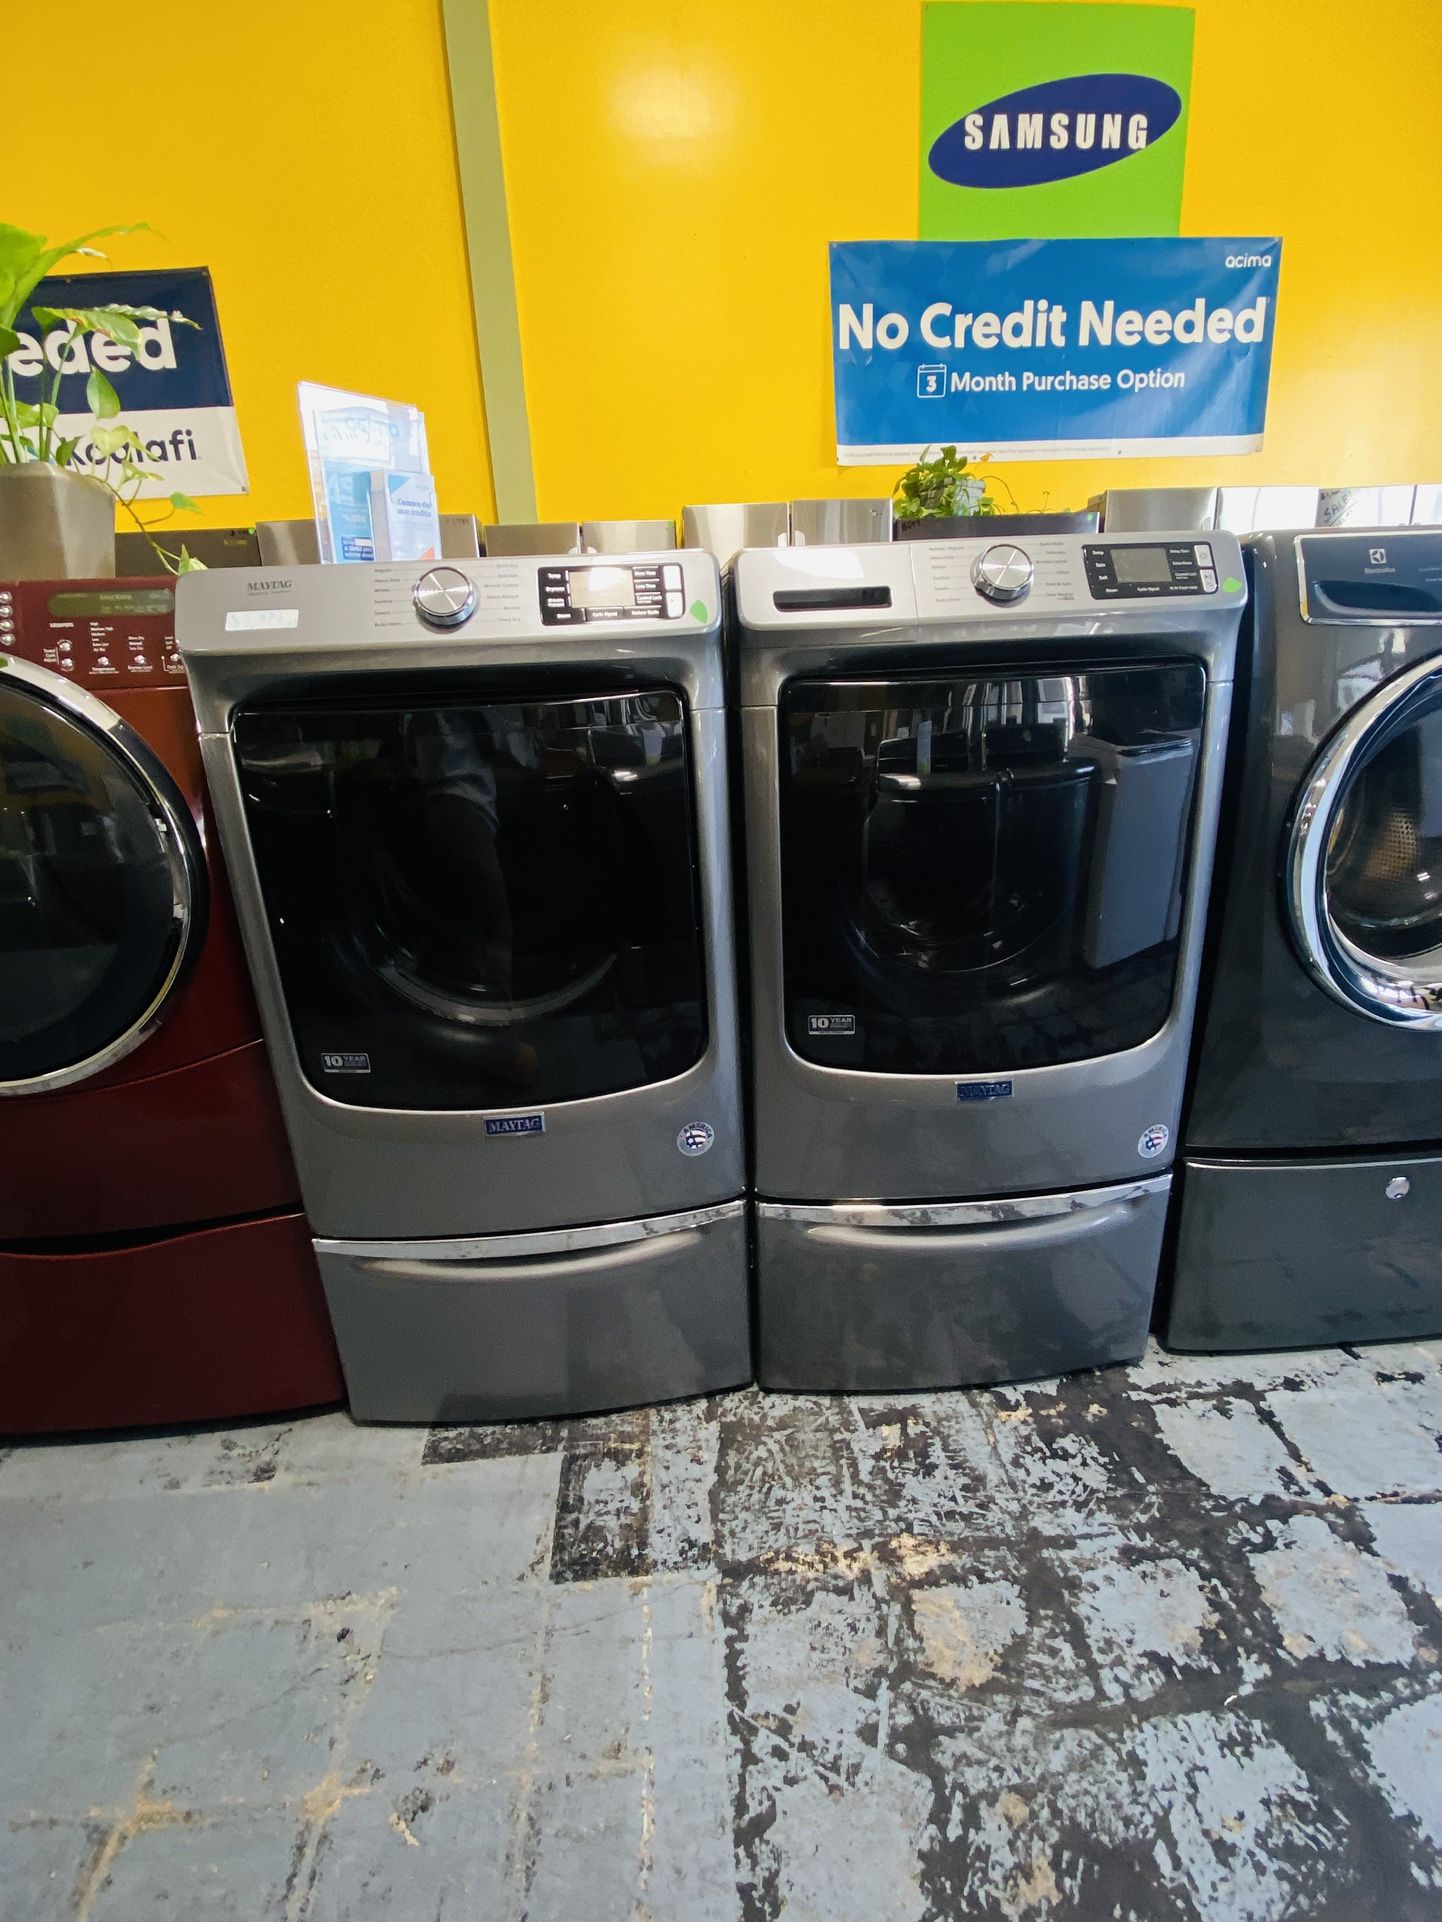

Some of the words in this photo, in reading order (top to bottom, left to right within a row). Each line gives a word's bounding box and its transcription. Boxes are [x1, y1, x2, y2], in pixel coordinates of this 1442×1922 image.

[964, 113, 1149, 151] SAMSUNG
[1225, 253, 1272, 269] acima
[839, 303, 909, 350] No
[920, 299, 1067, 349] Credit
[1078, 297, 1267, 346] Needed
[926, 375, 937, 393] 3
[950, 371, 1016, 393] Month
[1022, 370, 1112, 391] Purchase
[1116, 367, 1186, 393] Option
[1323, 493, 1350, 524] SALE
[247, 580, 292, 592] MAYTAG
[810, 1017, 829, 1029] 10
[324, 1055, 343, 1067] 10
[489, 1118, 540, 1133] MAYTAG
